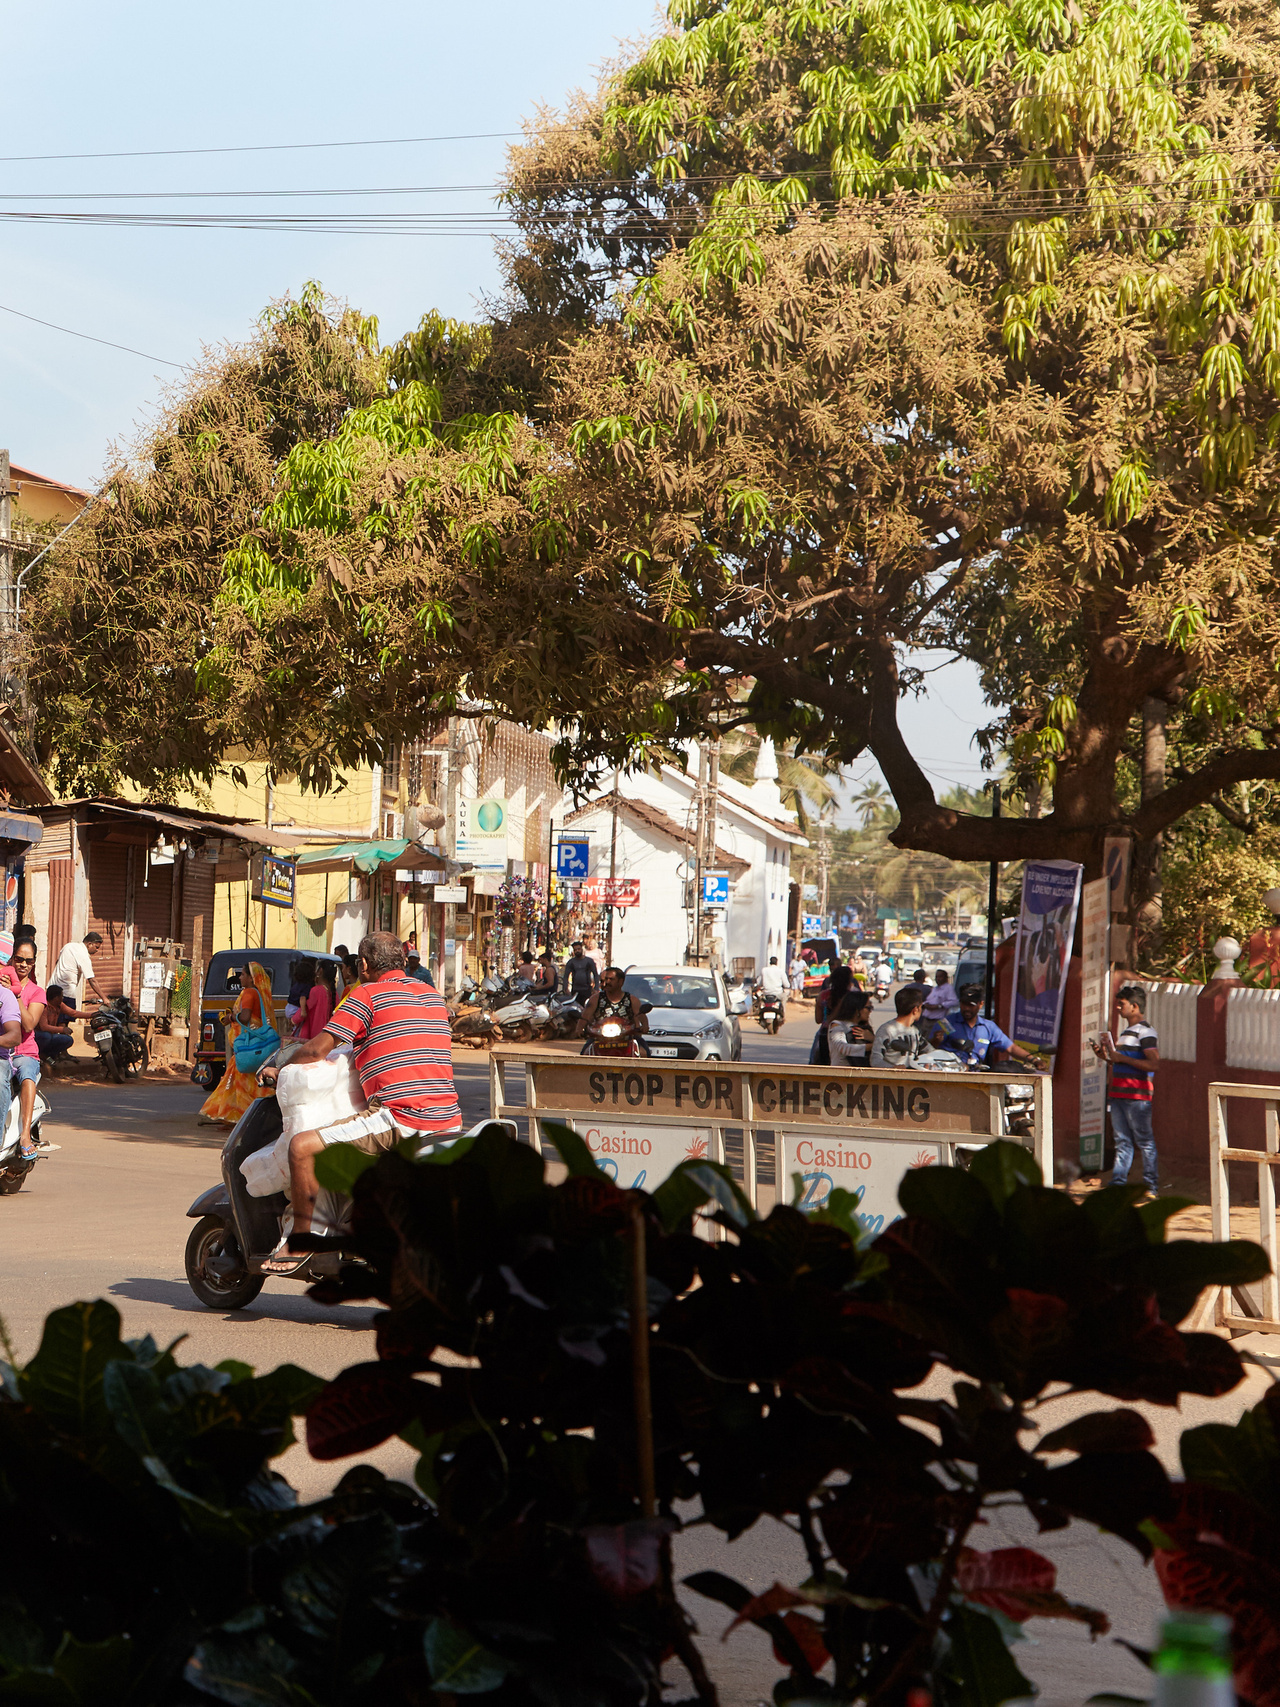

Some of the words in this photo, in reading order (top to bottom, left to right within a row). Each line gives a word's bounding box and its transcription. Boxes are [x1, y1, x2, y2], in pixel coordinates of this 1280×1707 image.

[560, 845, 577, 867] P
[706, 877, 719, 896] P
[589, 1071, 664, 1106] STOP
[674, 1075, 734, 1110] FOR
[757, 1078, 931, 1122] CHECKING
[585, 1128, 652, 1156] Casino
[796, 1141, 872, 1170] Casino
